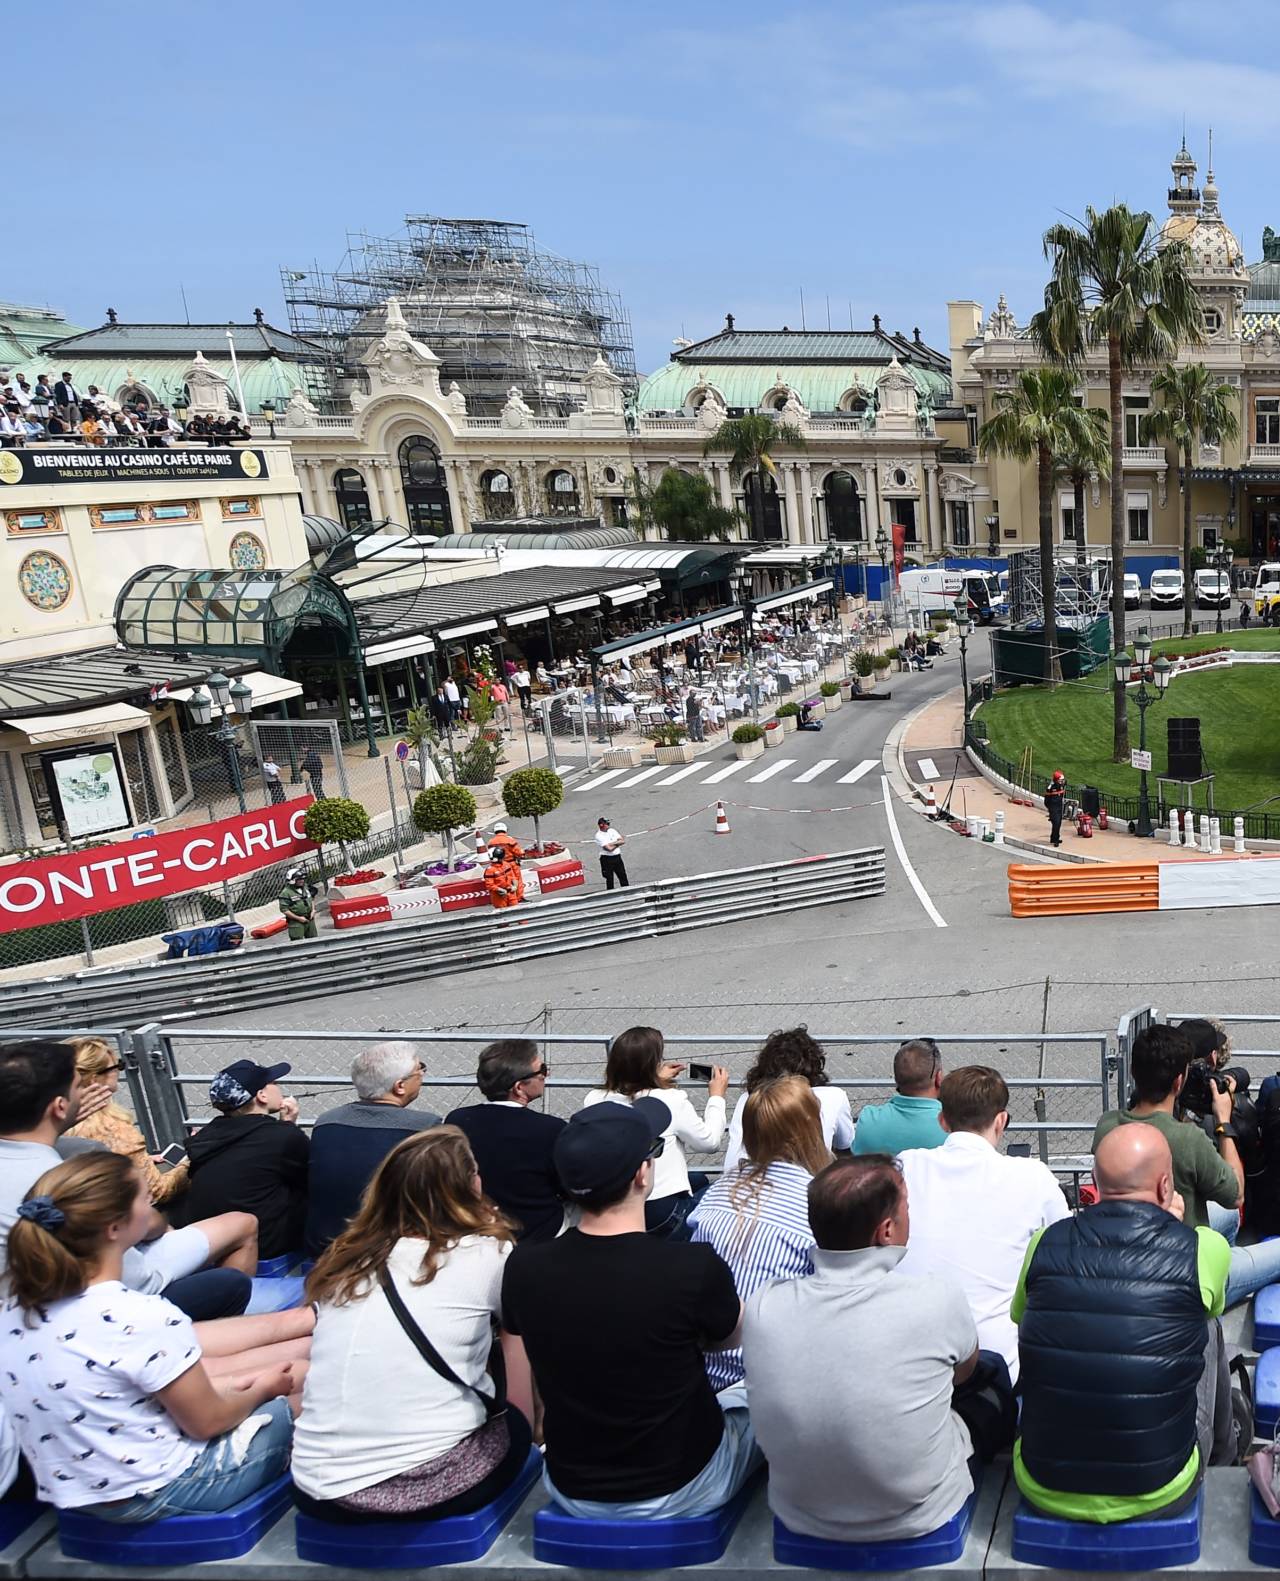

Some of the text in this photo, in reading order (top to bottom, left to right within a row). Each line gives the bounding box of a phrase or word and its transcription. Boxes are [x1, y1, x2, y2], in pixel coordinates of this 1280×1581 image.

[33, 452, 233, 467] BIENVENUE AU CASINO CAFÉ DE PARIS
[94, 469, 109, 477] JEUX
[117, 468, 148, 476] MACHINES
[177, 467, 199, 475] OUVERT
